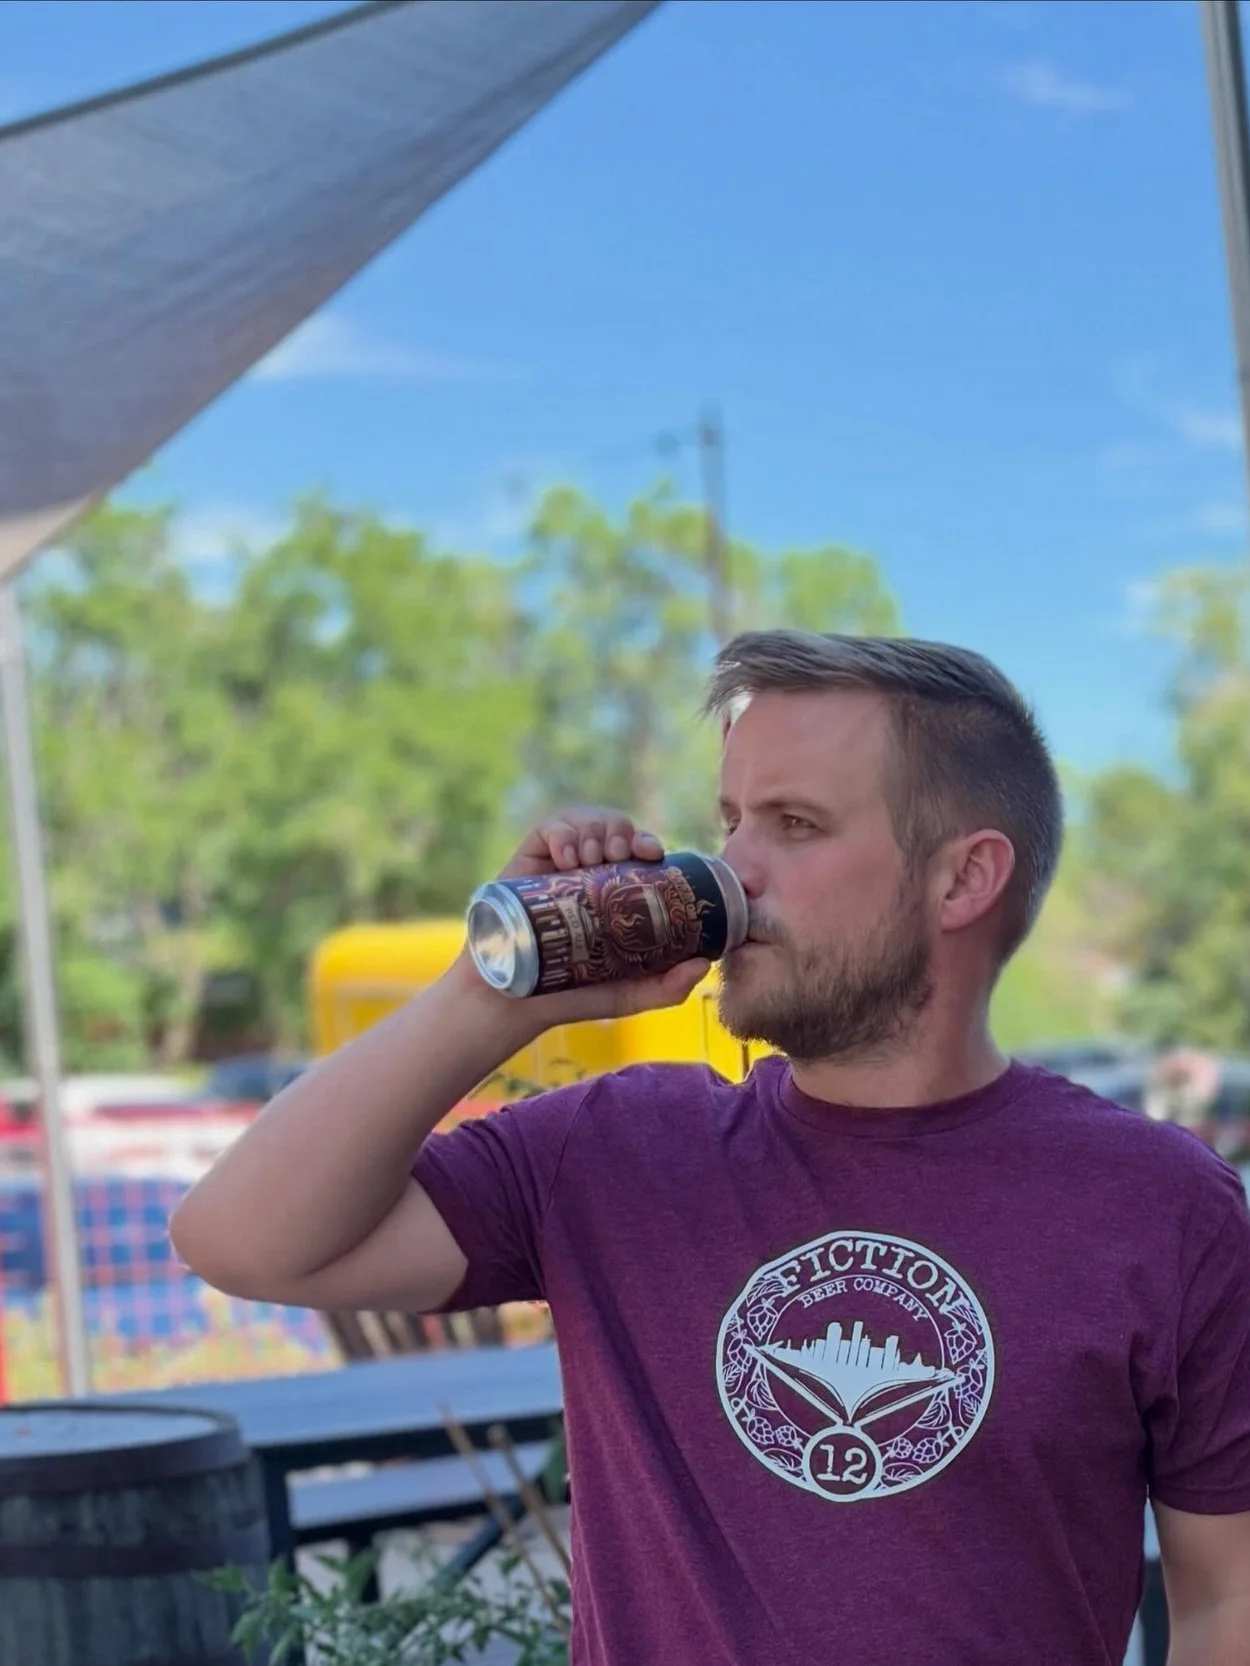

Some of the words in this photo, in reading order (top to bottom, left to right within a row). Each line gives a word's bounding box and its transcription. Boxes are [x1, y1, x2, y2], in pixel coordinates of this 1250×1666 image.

[778, 1239, 964, 1314] FICTION
[800, 1279, 849, 1309] BEER
[853, 1277, 929, 1322] COMPANY
[816, 1443, 869, 1484] 12
